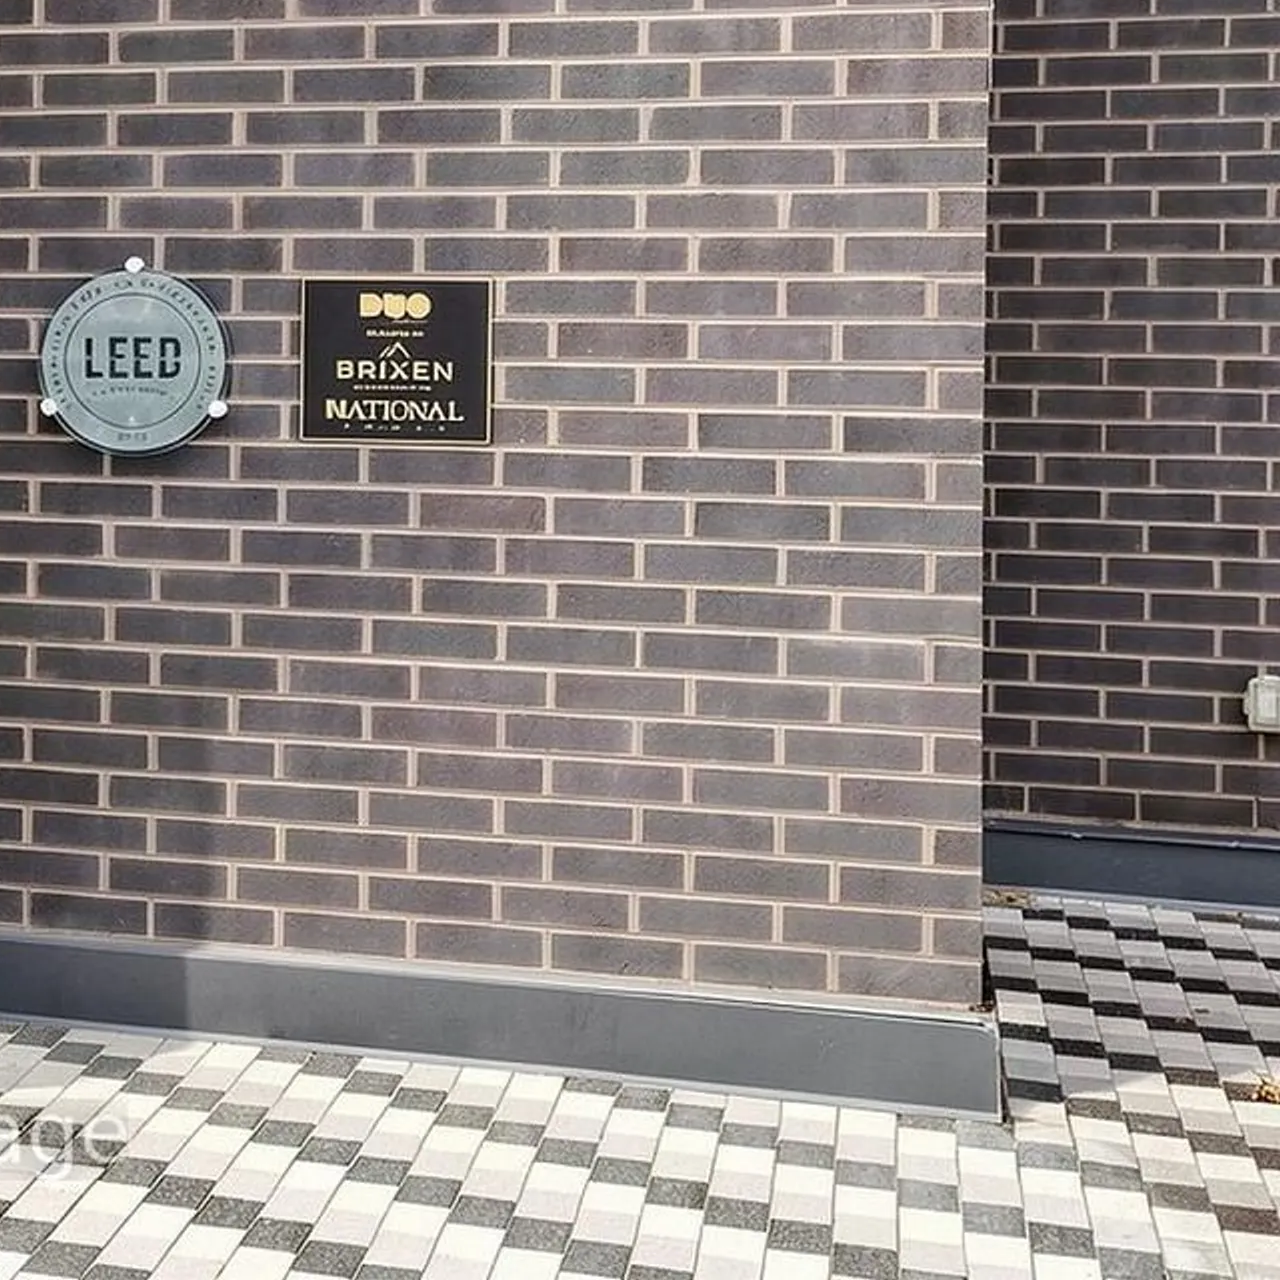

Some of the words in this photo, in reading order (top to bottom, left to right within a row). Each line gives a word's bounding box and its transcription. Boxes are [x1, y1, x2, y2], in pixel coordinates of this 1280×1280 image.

[359, 292, 432, 320] DUO
[85, 337, 182, 380] LEED
[335, 359, 454, 382] BRIXEN
[324, 398, 466, 422] NATIONAL
